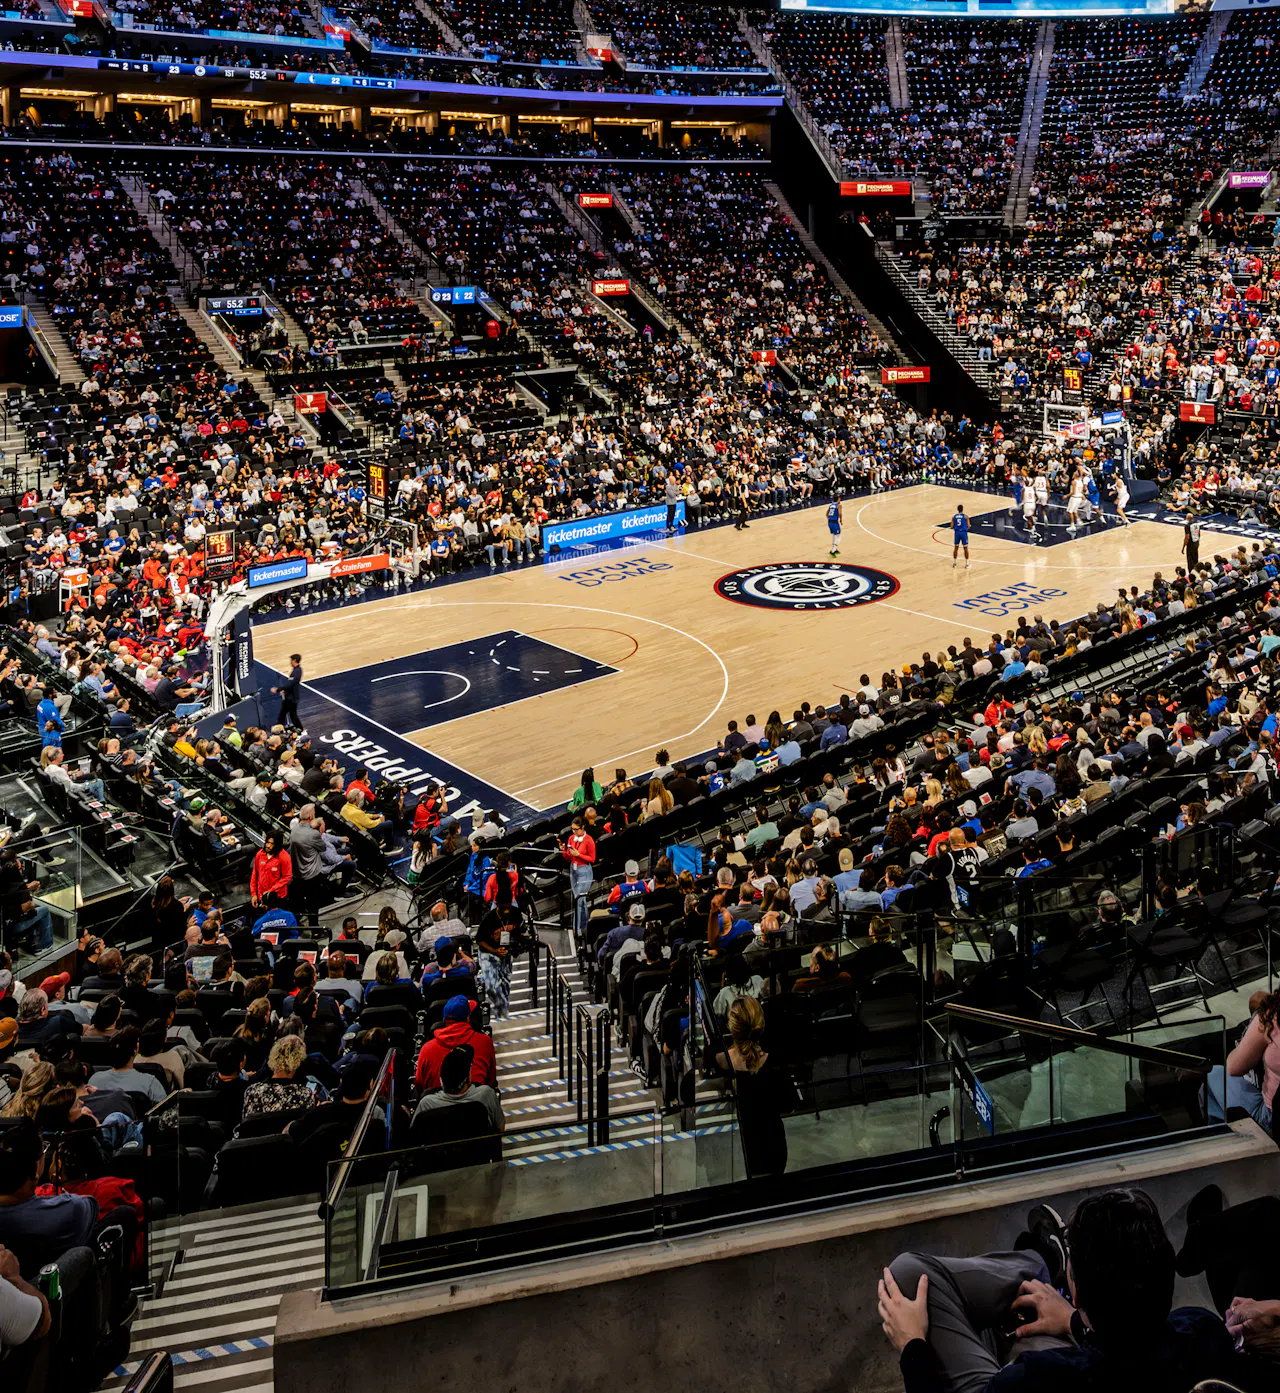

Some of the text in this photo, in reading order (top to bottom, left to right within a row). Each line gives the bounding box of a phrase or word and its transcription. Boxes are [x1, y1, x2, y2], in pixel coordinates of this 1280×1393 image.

[250, 70, 267, 80] 55.2
[442, 292, 473, 301] 23 22
[227, 300, 243, 308] 55.2
[1070, 377, 1081, 389] 13
[374, 478, 384, 497] 13
[548, 509, 681, 544] ticketmaster ticketmaser
[216, 543, 226, 554] 13
[253, 565, 303, 582] ticketmaster
[723, 578, 741, 598] LOS
[792, 578, 894, 611] CLIPPERS
